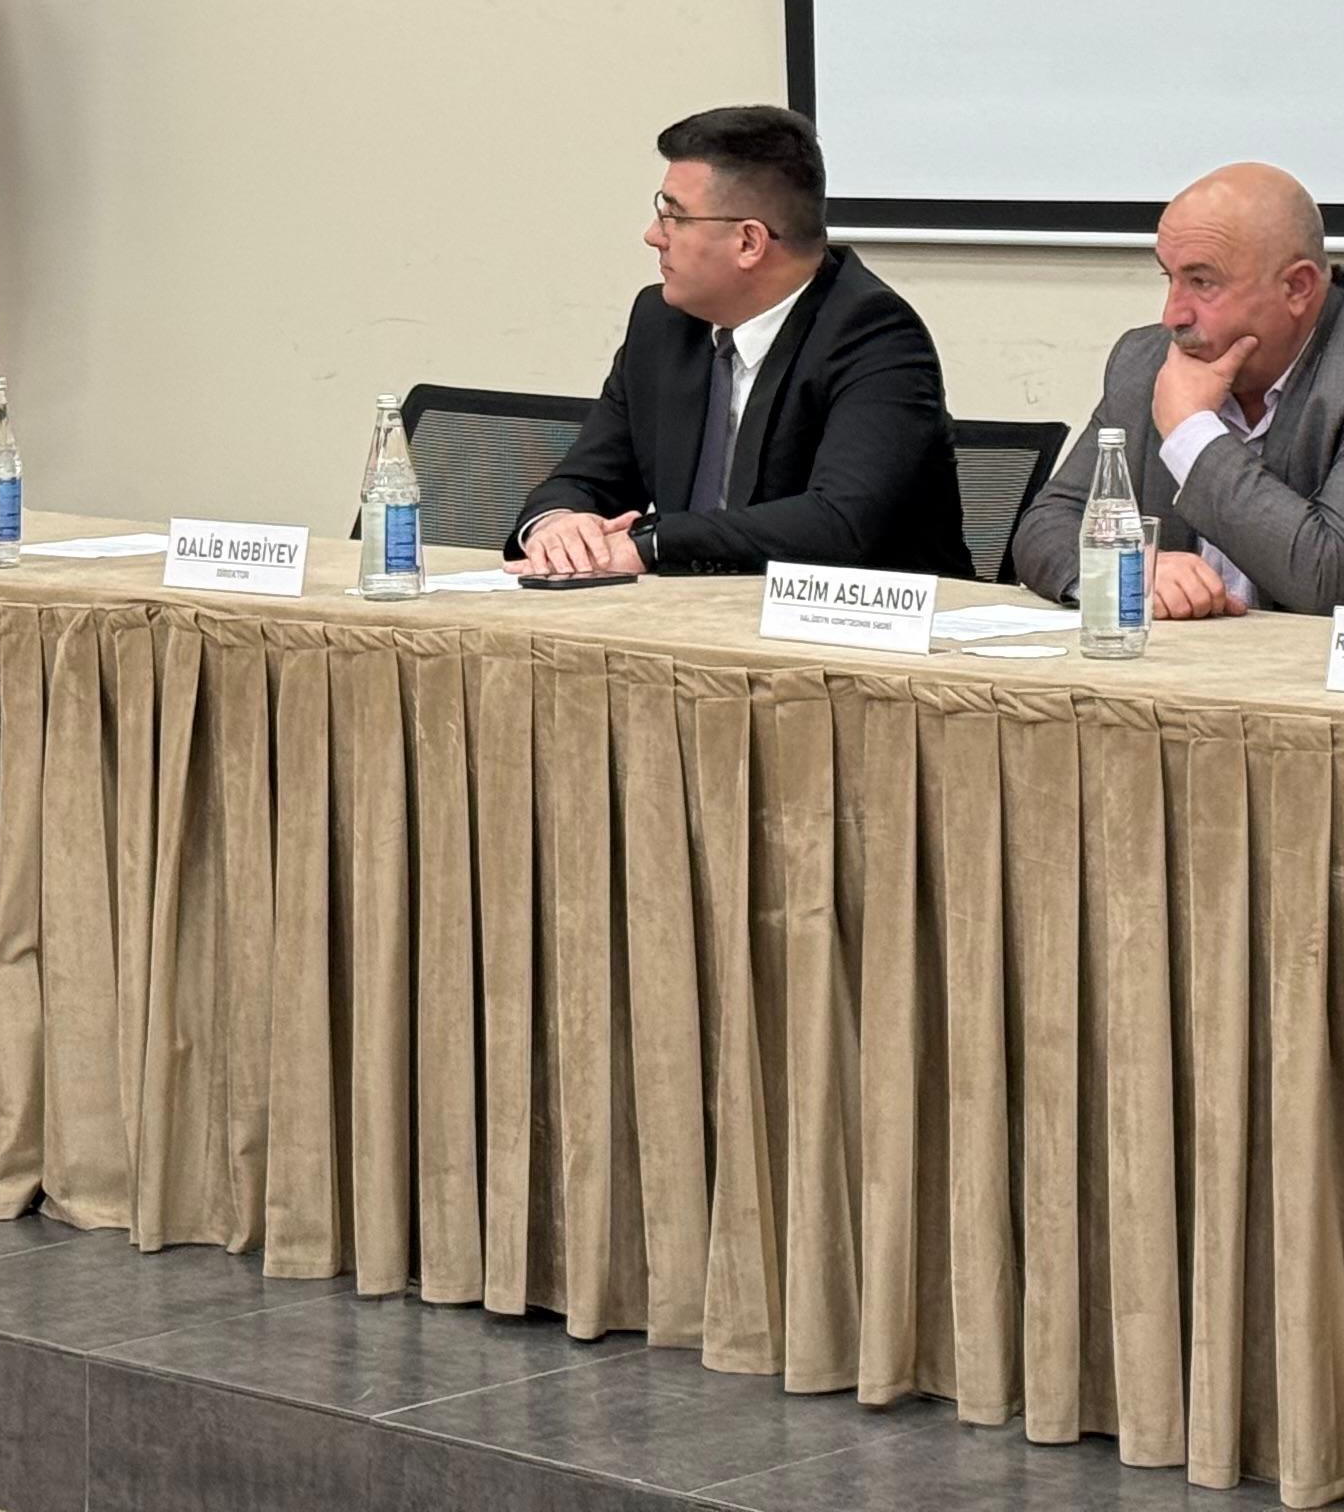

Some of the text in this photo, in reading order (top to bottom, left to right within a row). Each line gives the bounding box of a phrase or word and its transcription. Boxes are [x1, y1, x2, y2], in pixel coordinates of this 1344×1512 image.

[176, 532, 299, 564] QALİB NƏBİYEV
[769, 574, 927, 612] NAZİM ASLANOV
